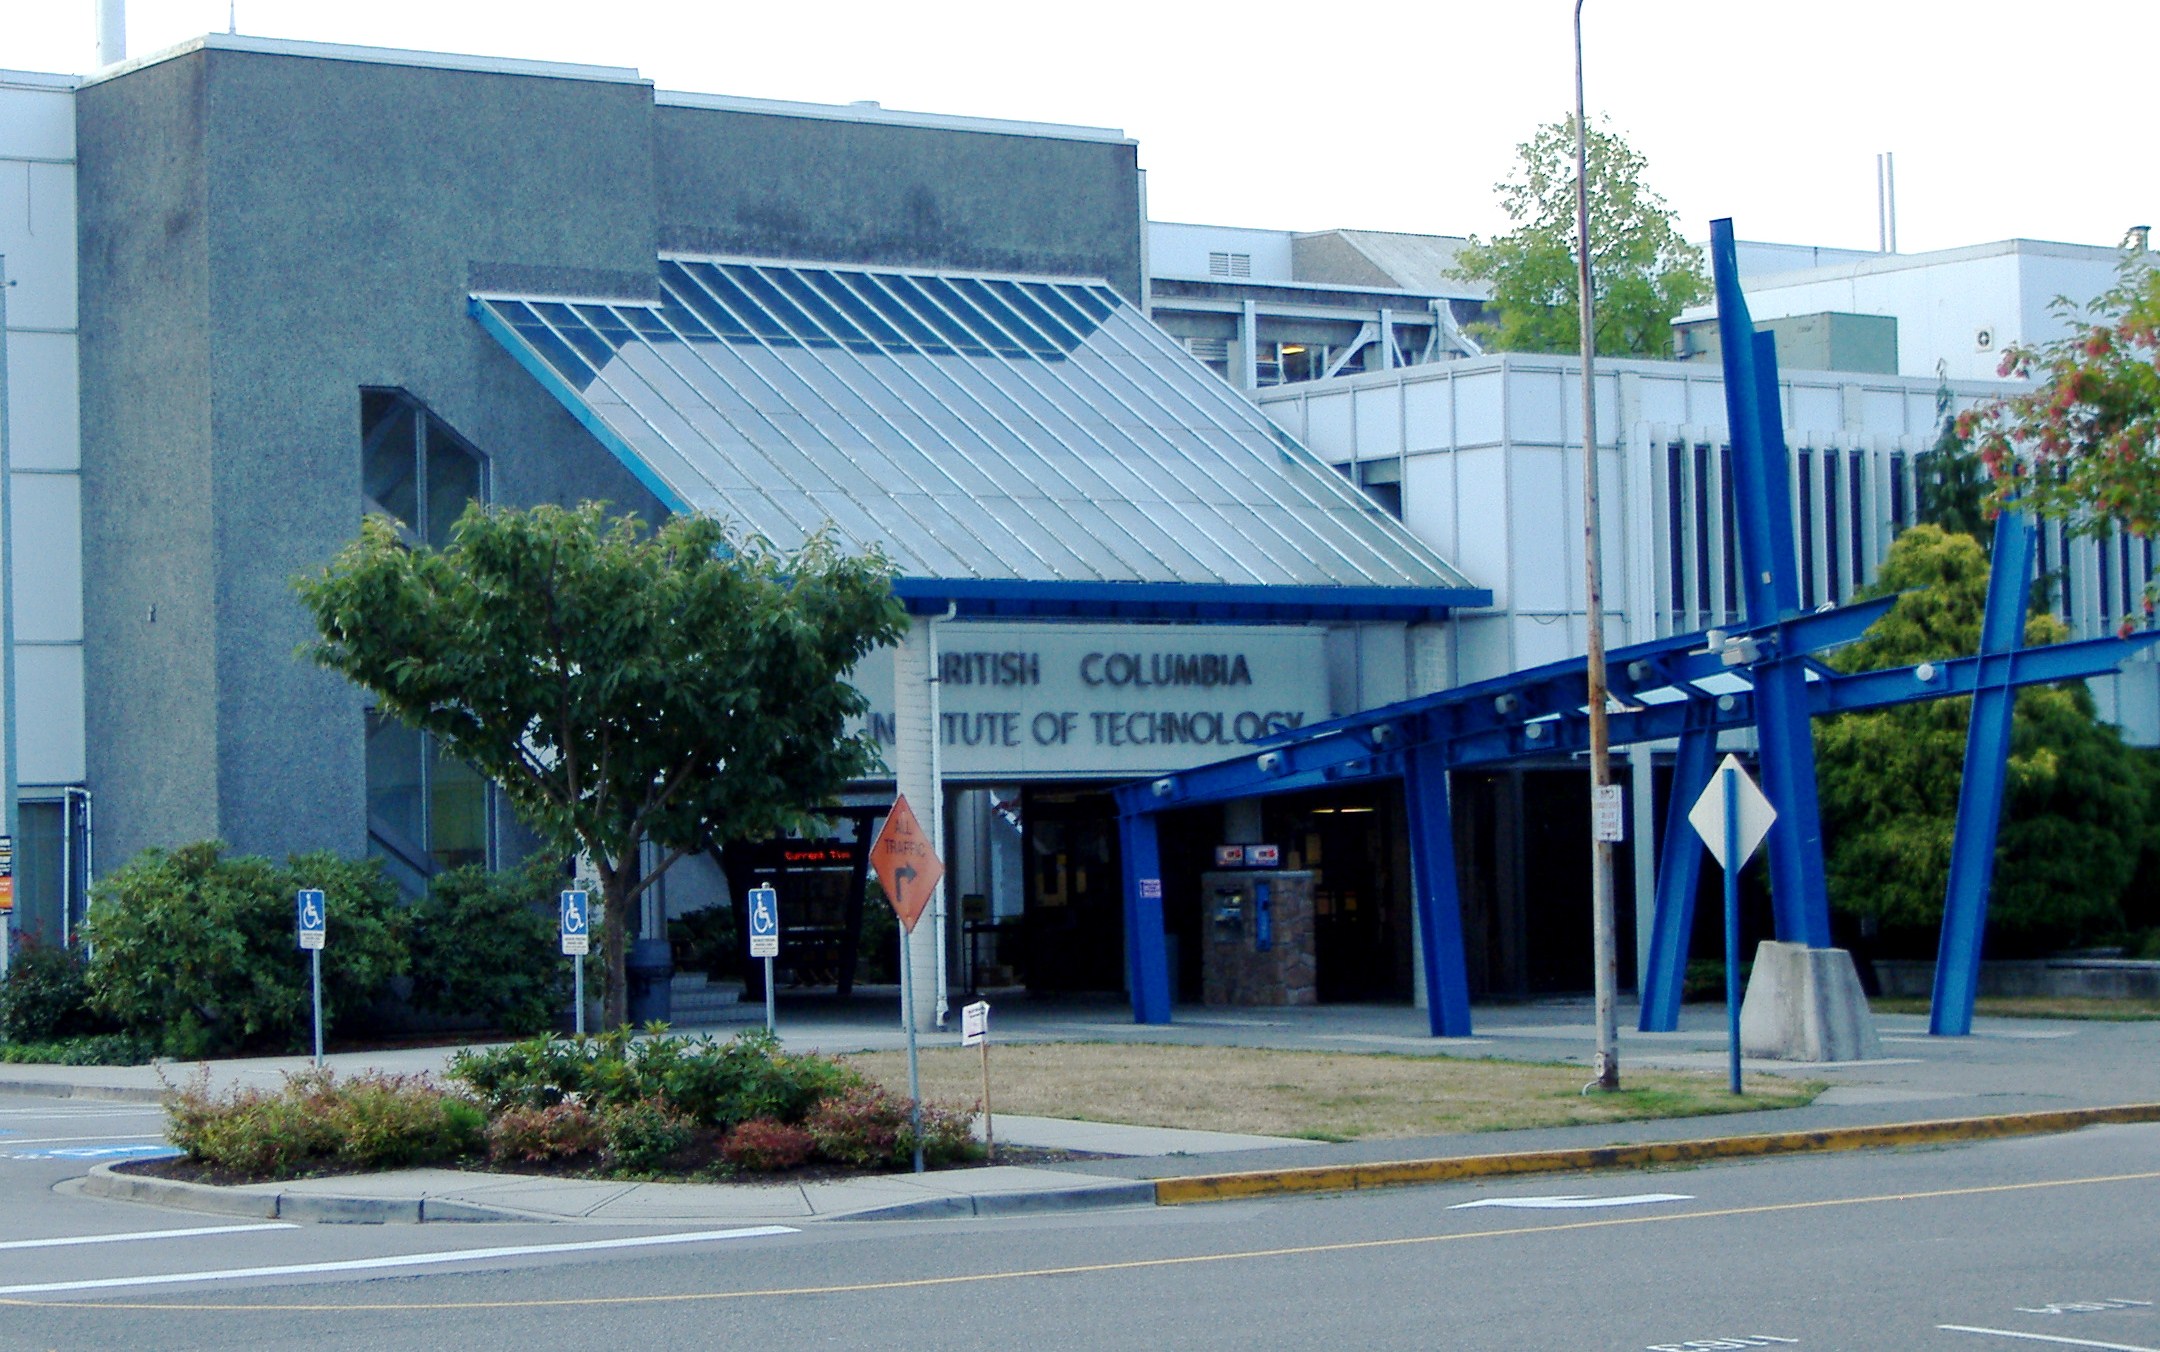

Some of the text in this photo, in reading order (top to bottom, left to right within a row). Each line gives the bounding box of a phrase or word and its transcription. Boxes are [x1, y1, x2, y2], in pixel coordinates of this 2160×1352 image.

[1081, 652, 1252, 686] COLUMBIA
[1032, 712, 1078, 746] OF
[895, 819, 913, 835] ALL
[884, 838, 926, 858] TRAFFIC
